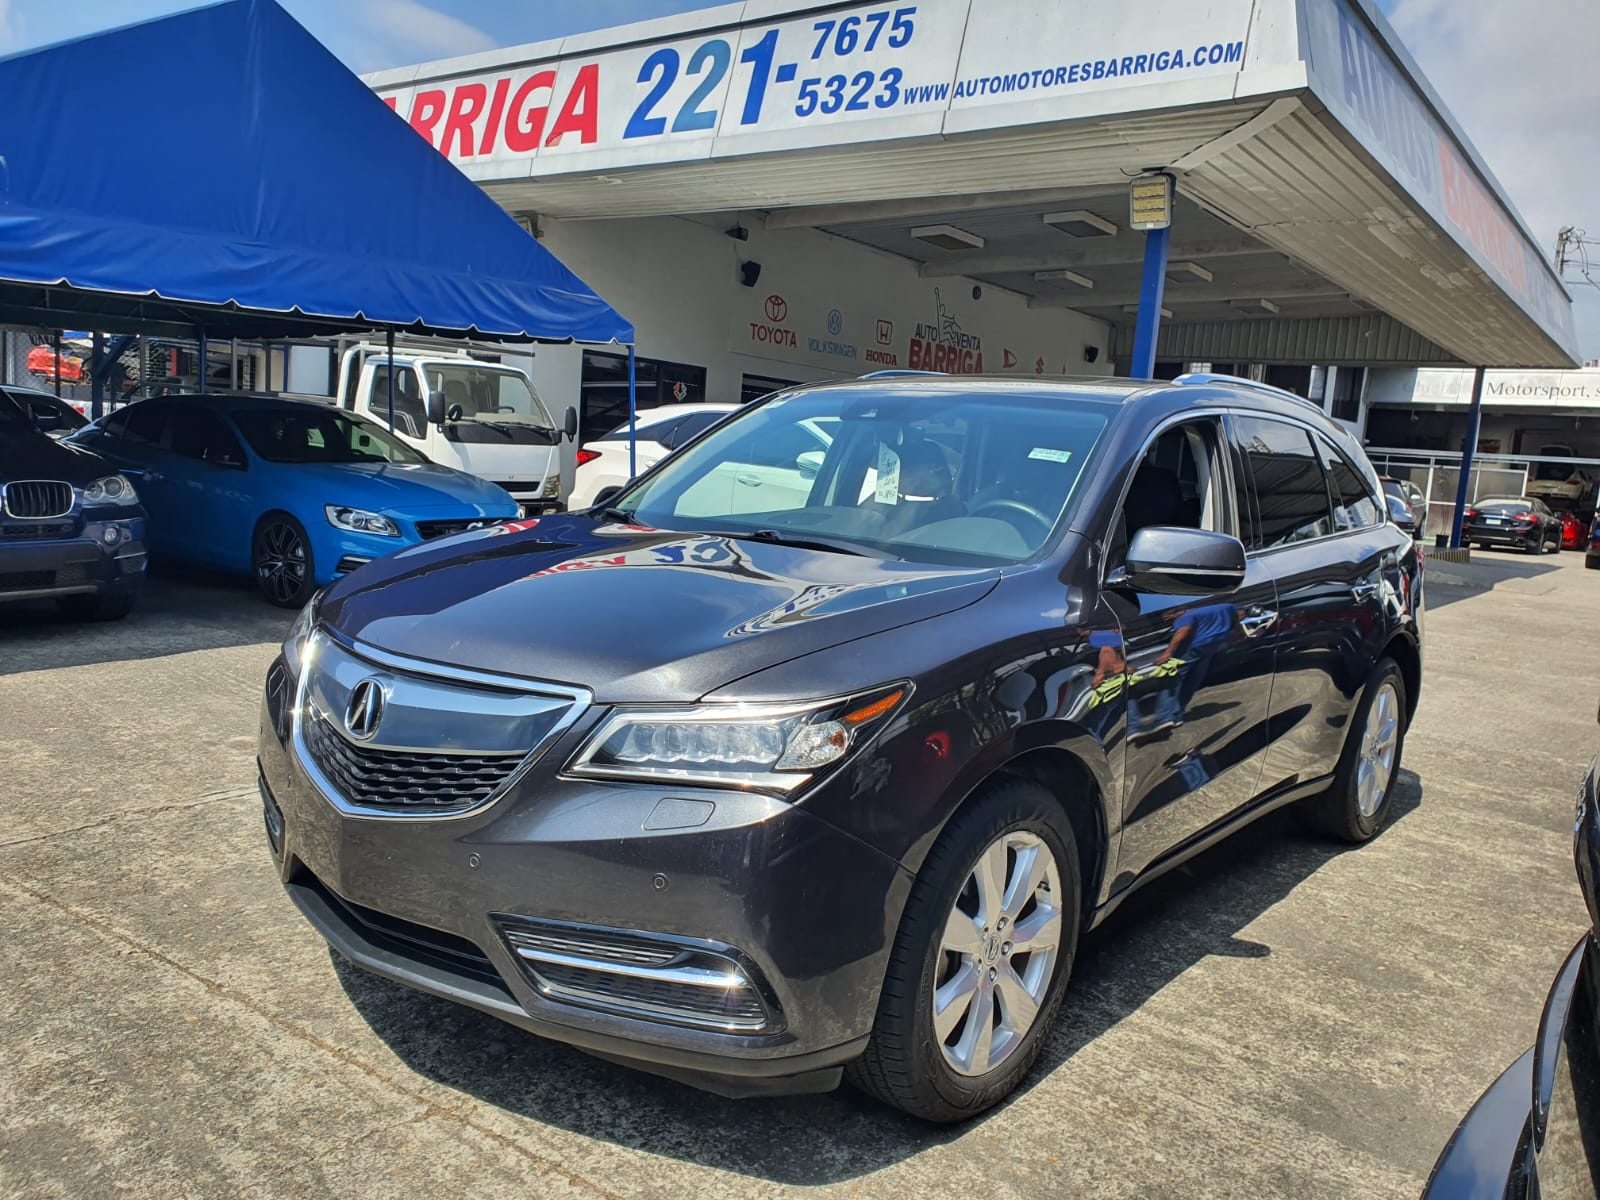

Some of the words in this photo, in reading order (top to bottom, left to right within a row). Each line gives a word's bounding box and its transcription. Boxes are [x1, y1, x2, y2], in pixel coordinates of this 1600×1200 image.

[811, 7, 917, 60] 7675
[953, 41, 1243, 99] AUTOMOTORESBARRIGA.COM
[795, 67, 903, 117] 5323
[384, 64, 599, 158] RRIGA
[750, 322, 797, 348] TOYOTA
[808, 336, 857, 360] VOLKSWAGEN
[915, 323, 938, 342] AUTO
[953, 331, 981, 352] VENTA
[866, 349, 897, 366] HONDA
[909, 338, 983, 375] BARRIGA
